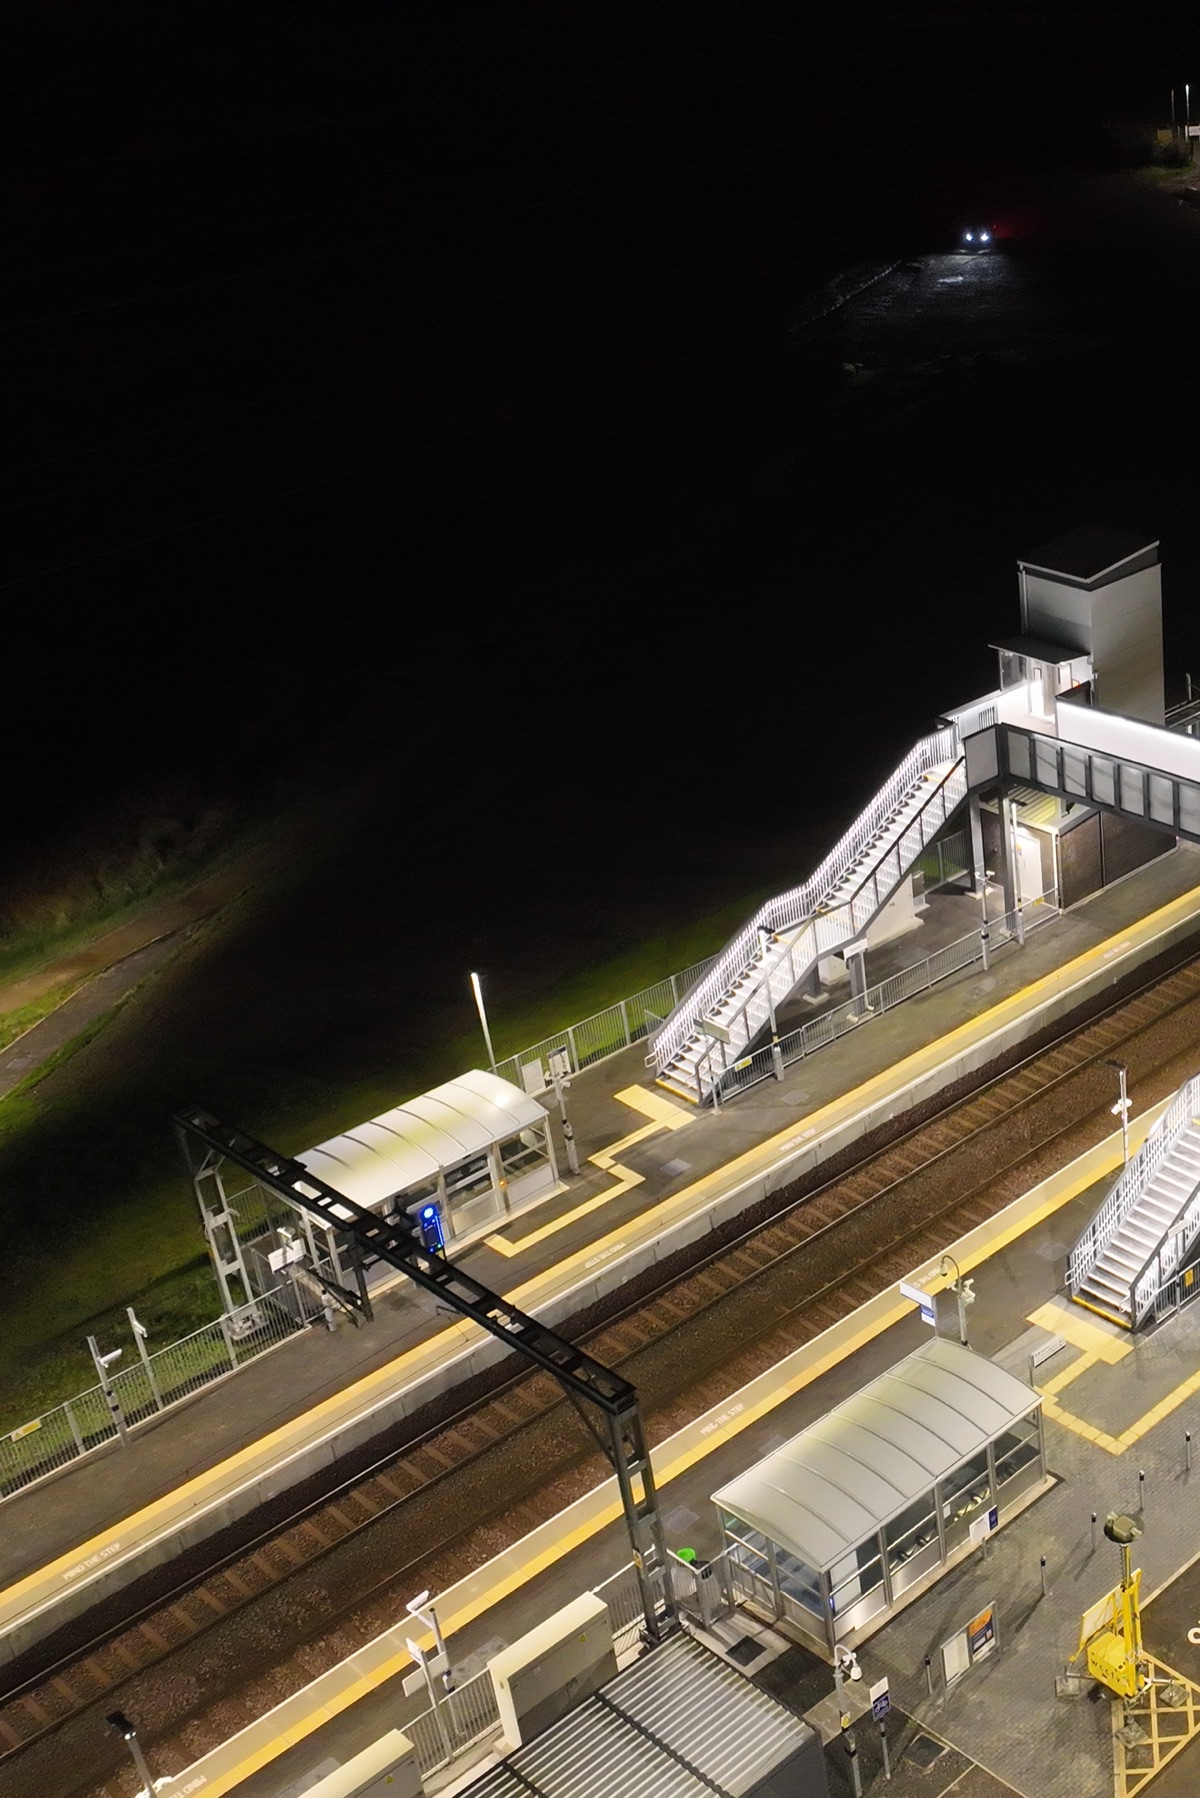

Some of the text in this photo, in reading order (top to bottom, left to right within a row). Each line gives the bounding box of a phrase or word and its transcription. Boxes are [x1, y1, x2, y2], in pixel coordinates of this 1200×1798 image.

[62, 1542, 120, 1580] MIND THE STEP
